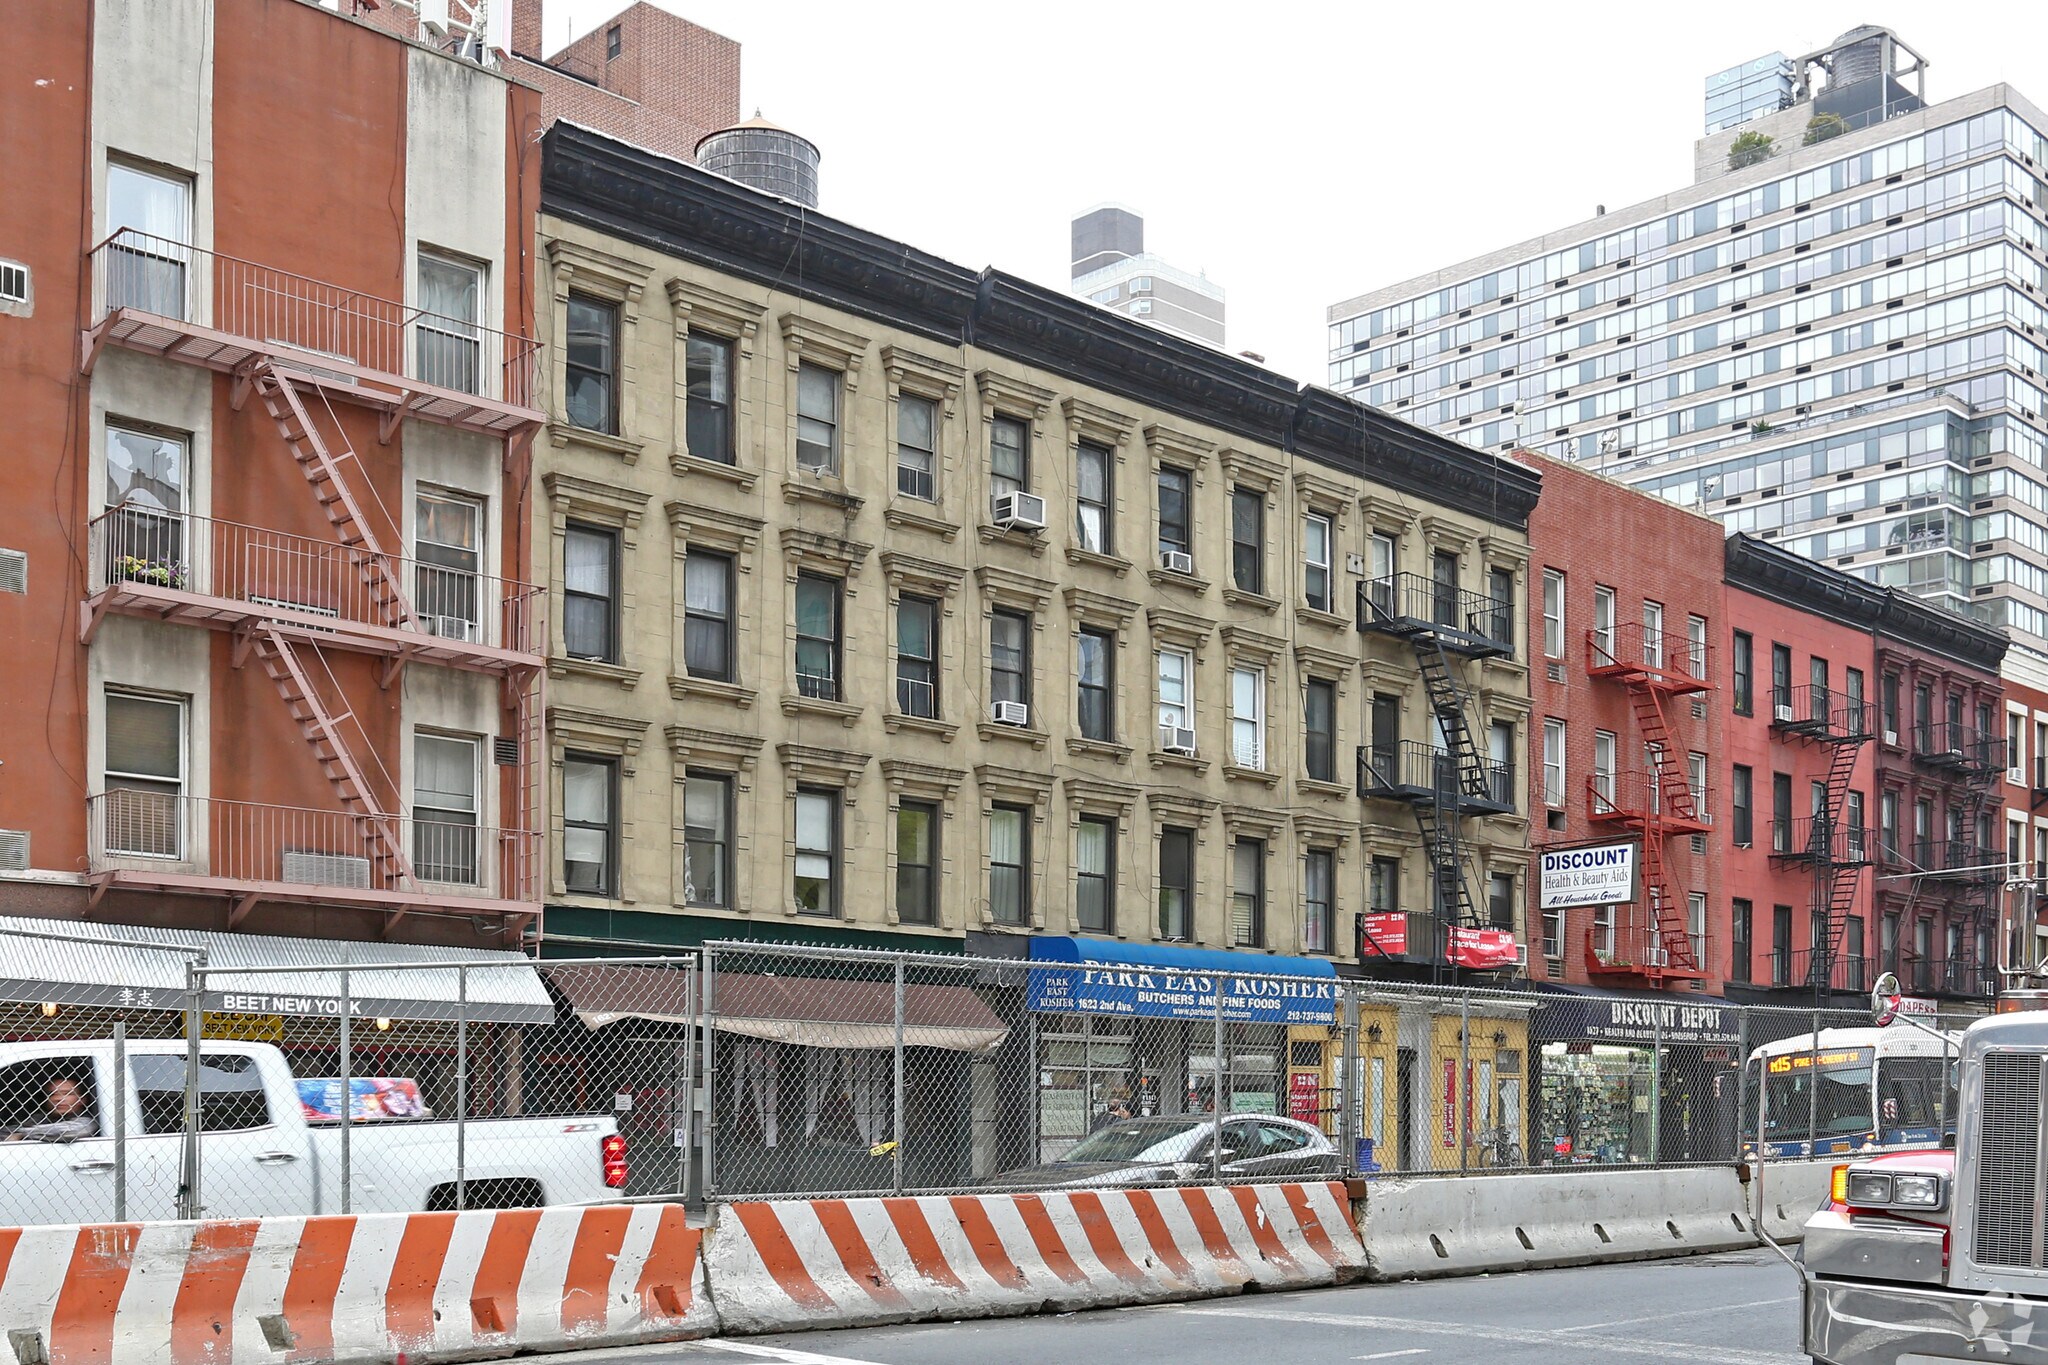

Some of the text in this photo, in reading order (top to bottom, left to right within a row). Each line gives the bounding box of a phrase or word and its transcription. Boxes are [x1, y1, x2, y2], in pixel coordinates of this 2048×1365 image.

[1545, 848, 1628, 871] DISCOUNT
[1545, 868, 1628, 890] Health & Beauty Aids
[1549, 890, 1623, 906] All Household Goods
[1046, 978, 1068, 987] PARK
[1082, 959, 1331, 999] PARK EAS KOSHER
[1046, 987, 1068, 996] EAST
[223, 994, 362, 1014] BEET NEW YOK
[1040, 998, 1074, 1008] KOSHER
[1078, 998, 1134, 1012] 1623 2nd Ave.
[1138, 991, 1194, 1006] BUTCHERS
[1222, 997, 1246, 1008] FINE
[1248, 998, 1281, 1010] FOODS
[592, 1012, 616, 1024] 1621
[1681, 1006, 1722, 1030] DEPOT
[205, 1023, 276, 1034] BEET NEW YORK
[1770, 1056, 1791, 1073] M15
